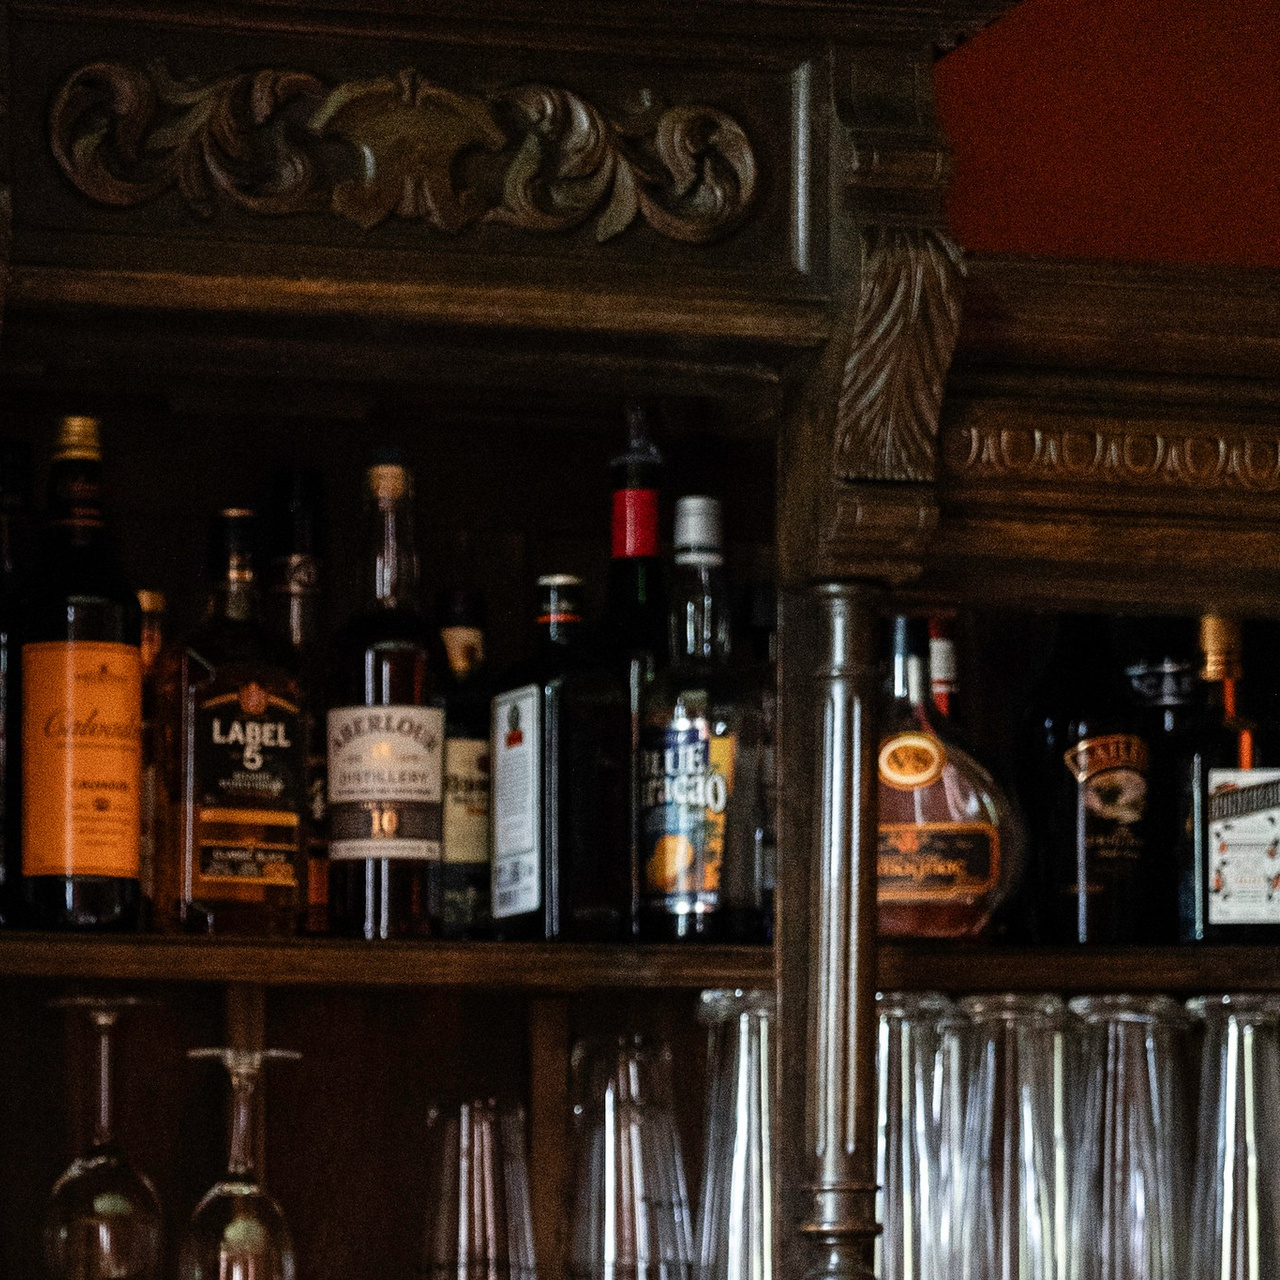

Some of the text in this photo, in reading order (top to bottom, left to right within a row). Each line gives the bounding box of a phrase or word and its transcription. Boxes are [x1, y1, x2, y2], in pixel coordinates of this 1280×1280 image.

[210, 717, 292, 750] LABEL
[241, 744, 264, 771] 5
[370, 808, 399, 836] 10
